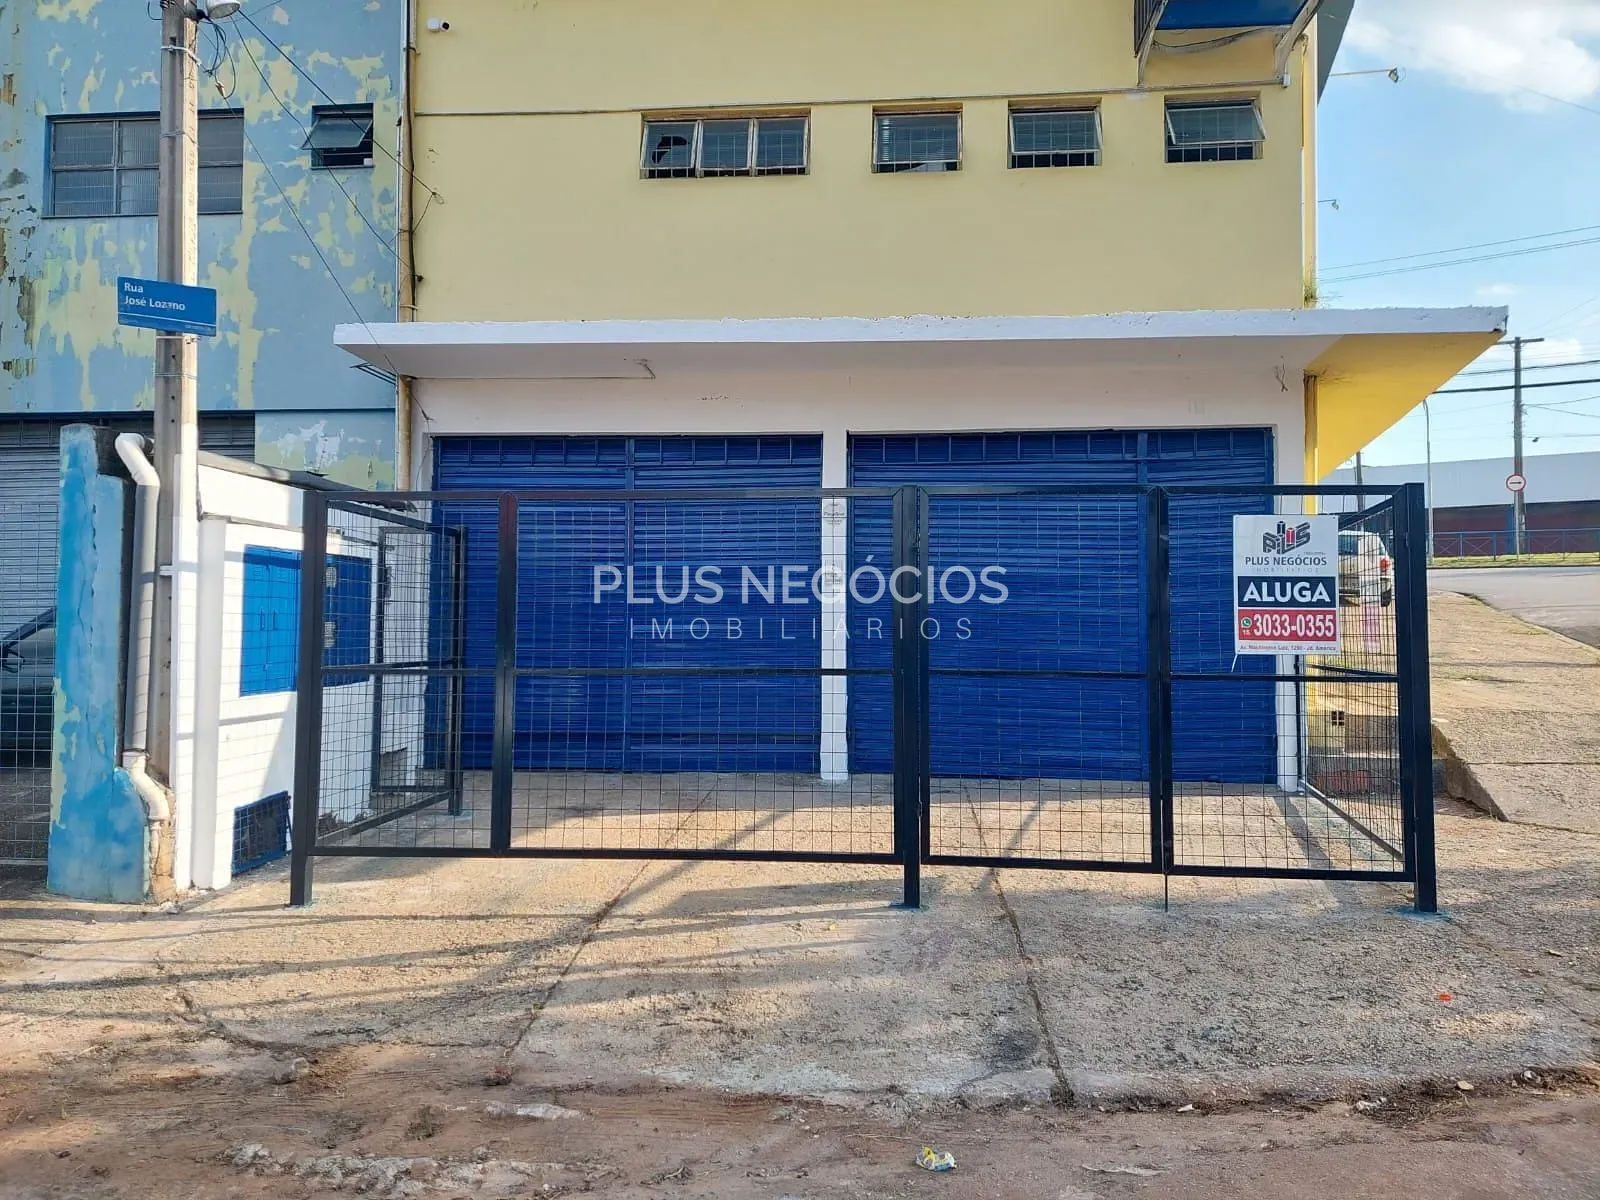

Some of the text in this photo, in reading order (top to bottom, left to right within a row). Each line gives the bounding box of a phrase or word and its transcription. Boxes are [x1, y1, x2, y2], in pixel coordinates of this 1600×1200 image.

[124, 282, 144, 293] Rua
[124, 295, 186, 311] José Lozano
[1245, 553, 1328, 566] PLUS NEGÓCIOS
[1242, 581, 1332, 603] ALUGA
[1253, 613, 1335, 637] 3033-0355
